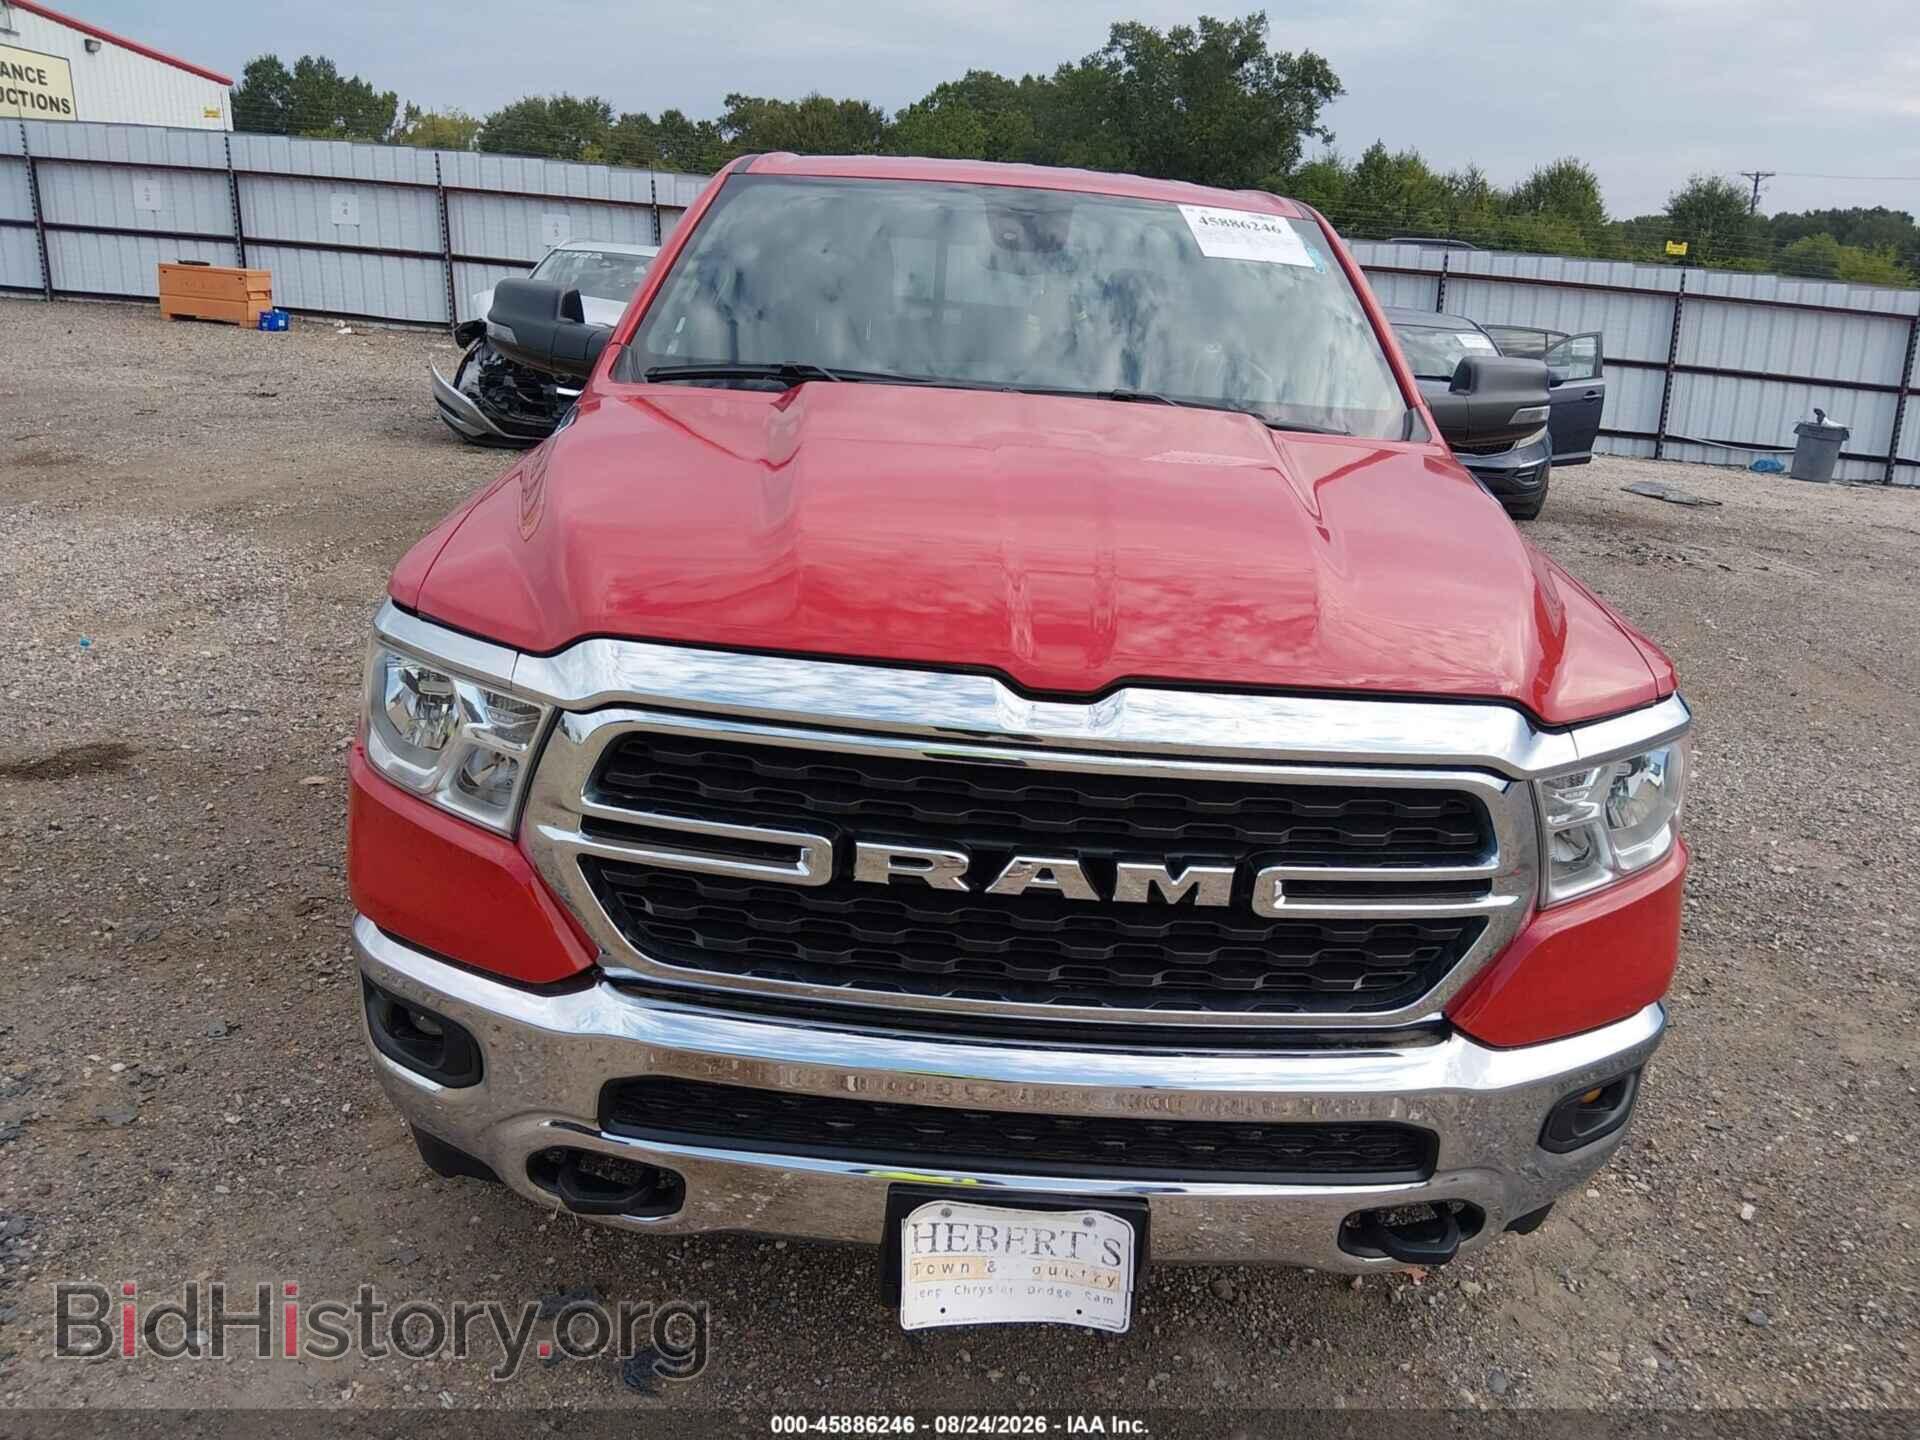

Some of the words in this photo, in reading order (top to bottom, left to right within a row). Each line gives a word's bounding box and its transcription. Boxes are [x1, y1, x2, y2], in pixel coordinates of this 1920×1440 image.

[1199, 216, 1282, 233] 45886246
[854, 842, 1236, 907] RAM
[912, 1261, 970, 1276] Town
